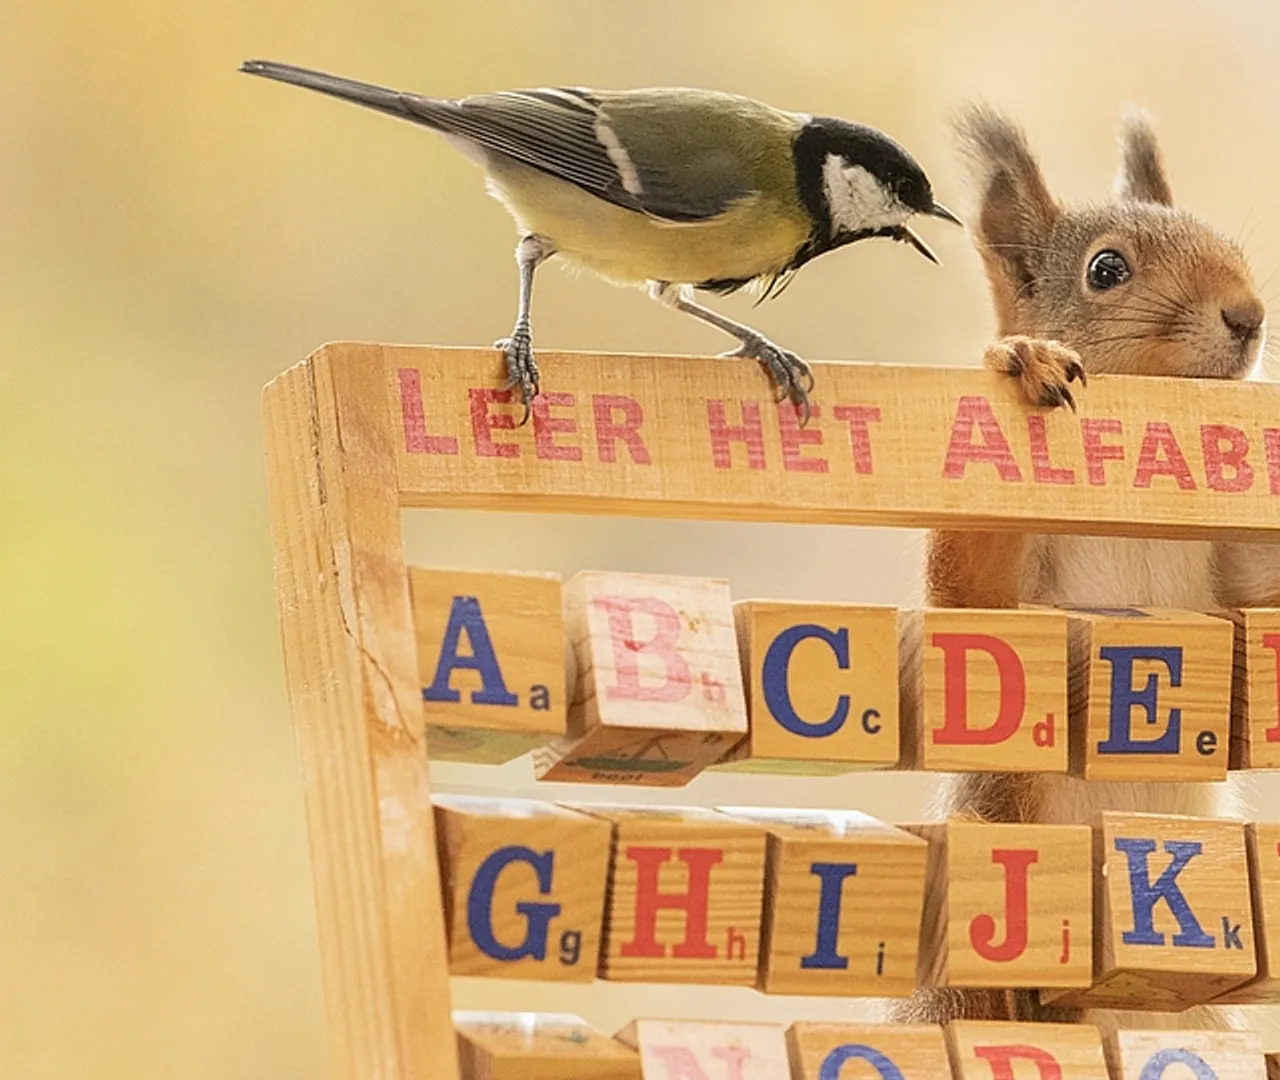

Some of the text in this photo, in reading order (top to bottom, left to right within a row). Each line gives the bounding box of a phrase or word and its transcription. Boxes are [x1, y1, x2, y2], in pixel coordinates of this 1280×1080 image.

[398, 368, 652, 465] LEER
[707, 399, 881, 474] HET
[422, 596, 550, 711] A a
[593, 594, 693, 702] B
[762, 624, 881, 738] C c
[932, 632, 1055, 748] D d
[1097, 646, 1217, 756] E e
[466, 845, 582, 966] G g
[620, 847, 745, 961] H h
[801, 863, 885, 975] I i
[969, 848, 1070, 964] J j
[1114, 837, 1243, 950] K k
